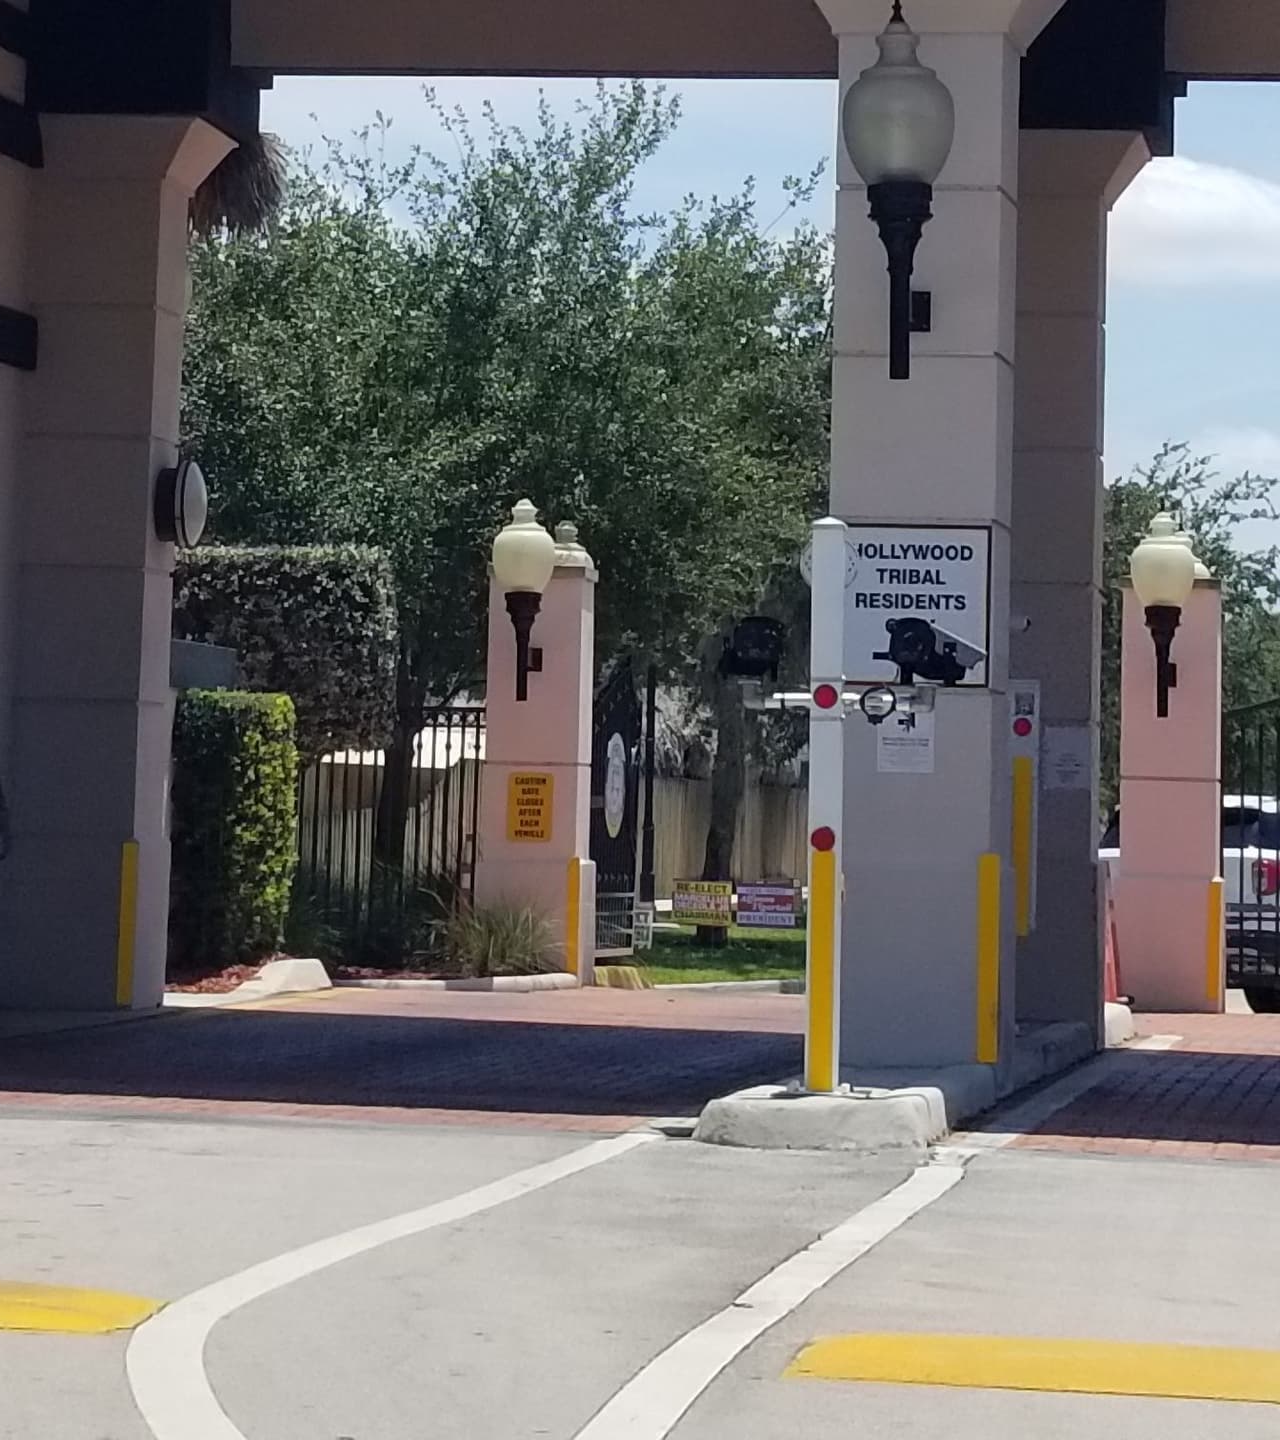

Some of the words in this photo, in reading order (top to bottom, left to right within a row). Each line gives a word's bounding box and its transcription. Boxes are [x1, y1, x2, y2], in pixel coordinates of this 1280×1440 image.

[876, 568, 946, 585] TRIBAL
[855, 593, 966, 610] RESIDENTS
[515, 777, 547, 785] CAUTION
[520, 819, 539, 827] EACH
[514, 830, 544, 838] VEHICLE
[677, 882, 728, 894] RE-ELECT
[674, 910, 729, 921] CHAIRMAN
[738, 914, 792, 924] PRESIDENT
